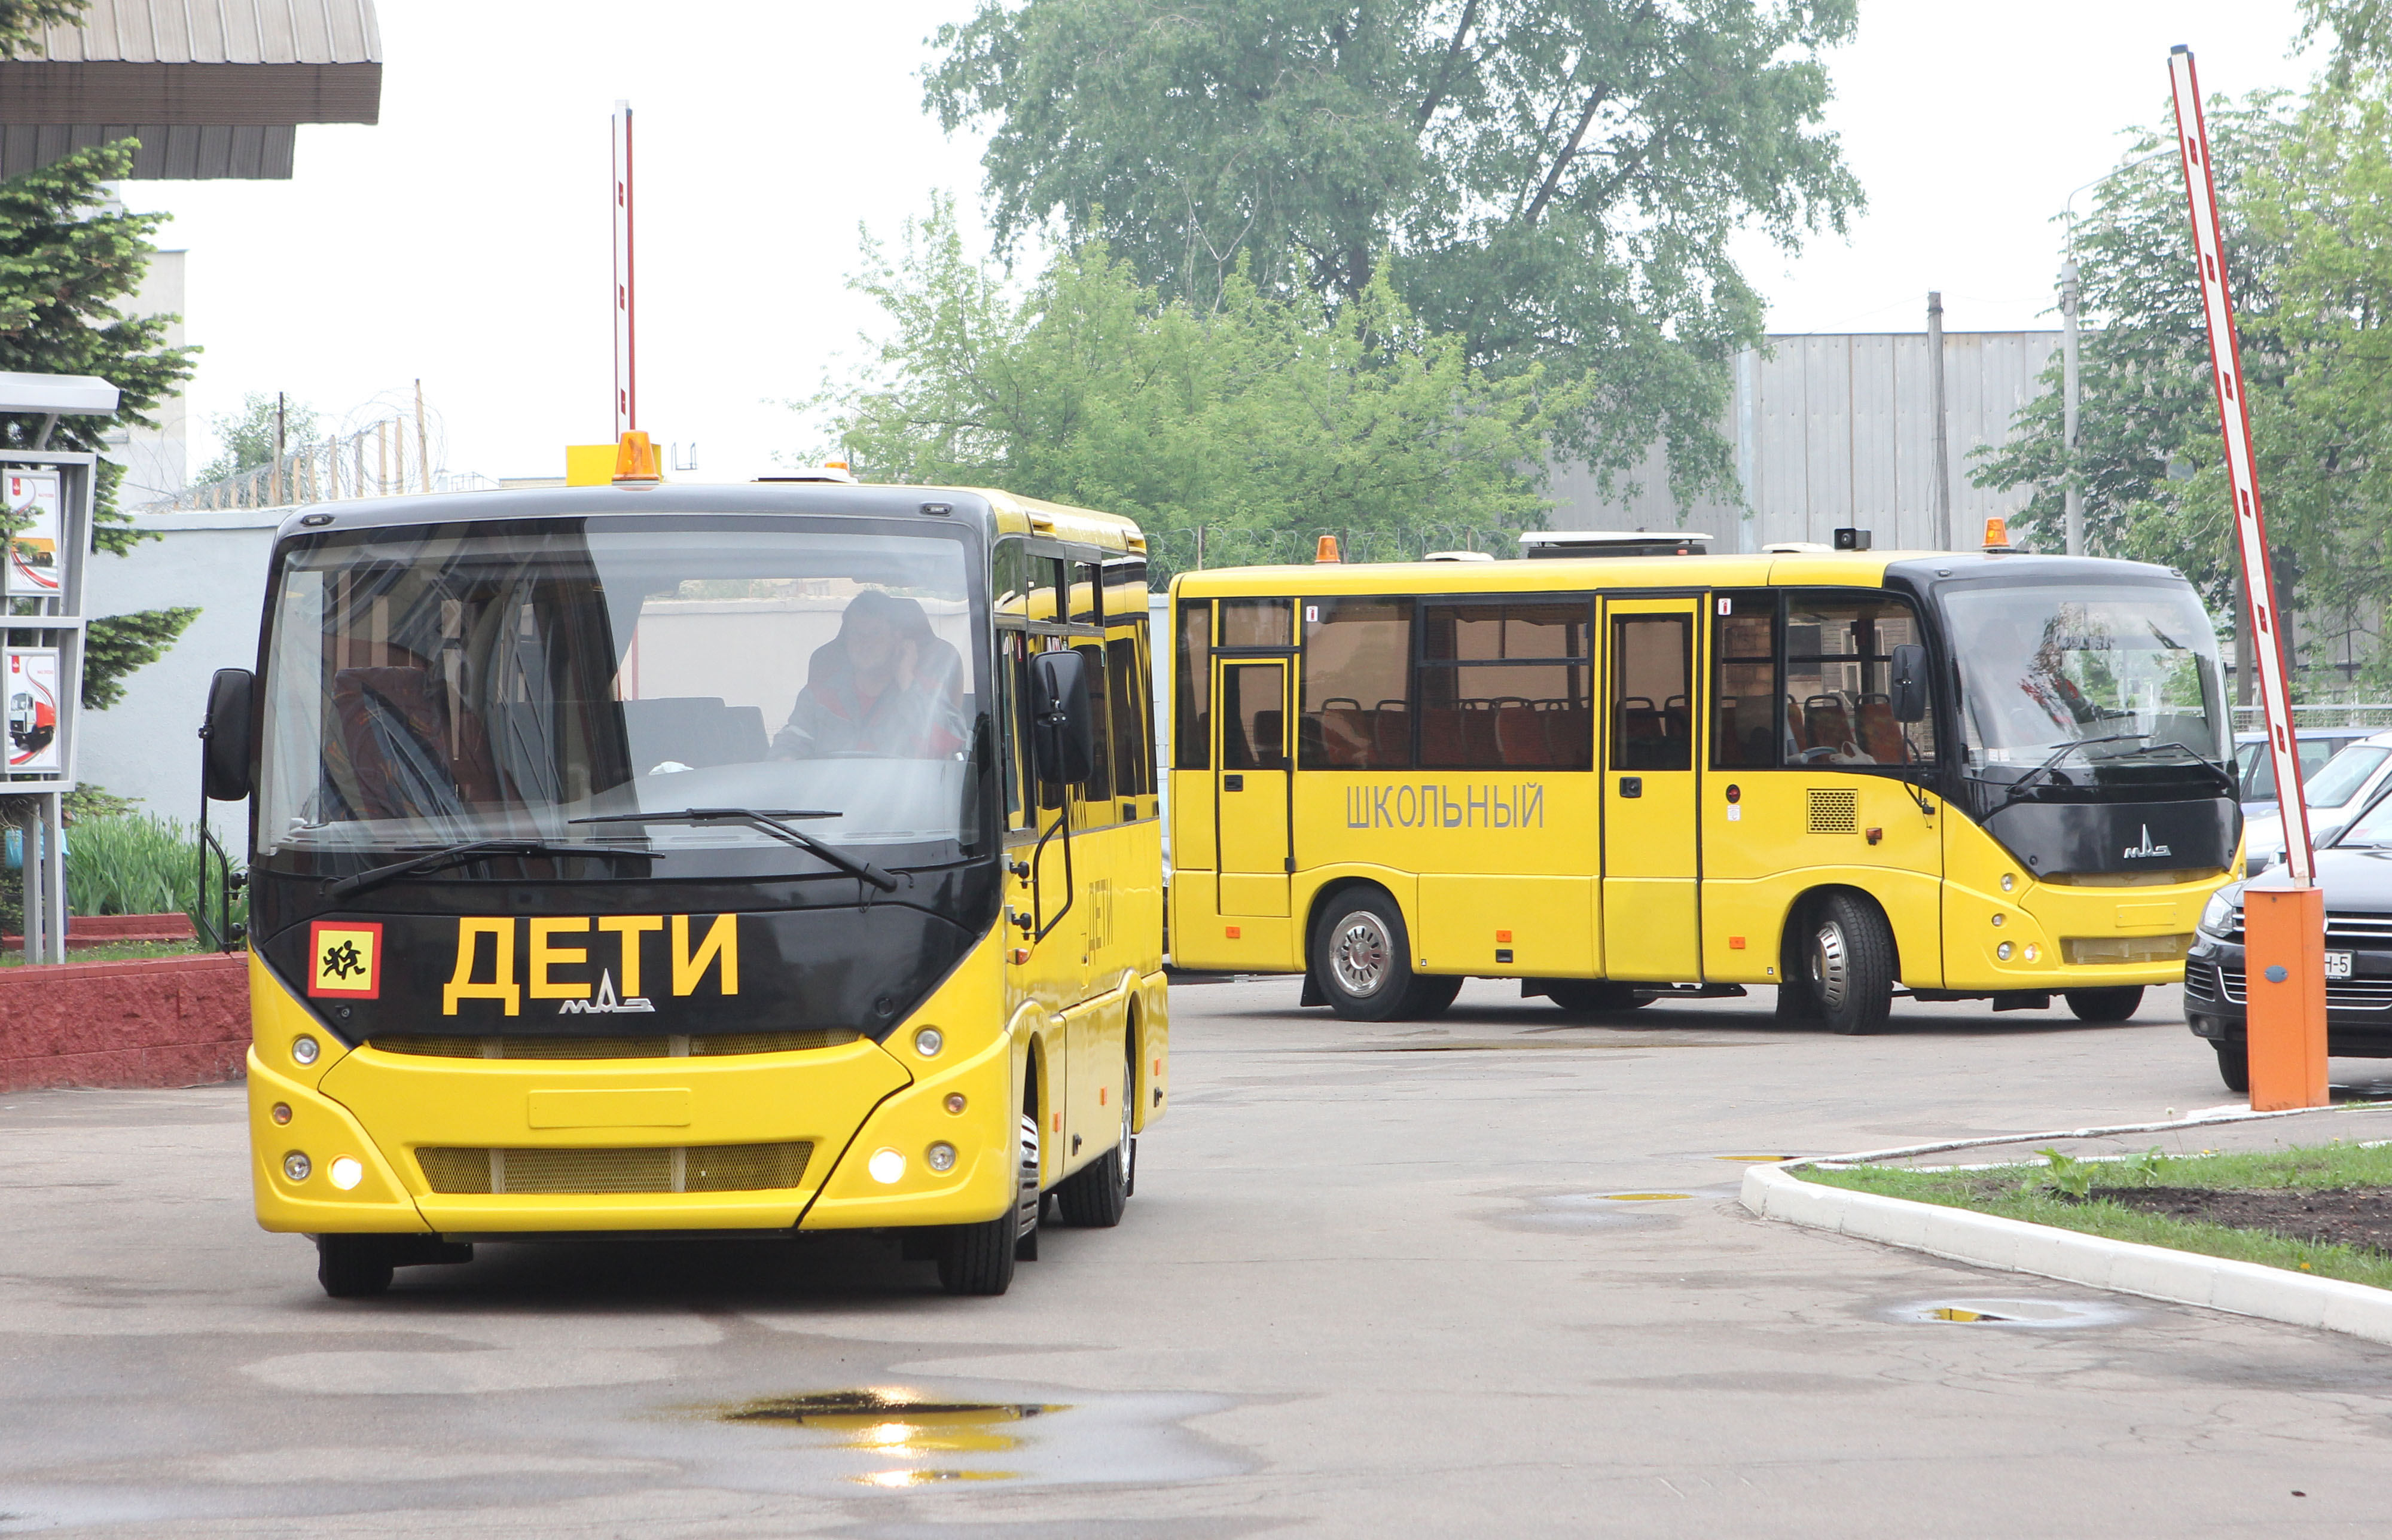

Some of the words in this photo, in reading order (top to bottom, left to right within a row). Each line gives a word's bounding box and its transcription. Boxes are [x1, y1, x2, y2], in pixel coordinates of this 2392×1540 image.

[1347, 782, 1543, 829] ШКОЛЬНЫЙ
[443, 913, 739, 1016] ДЕТИ
[1088, 878, 1113, 967] ДЕТИ
